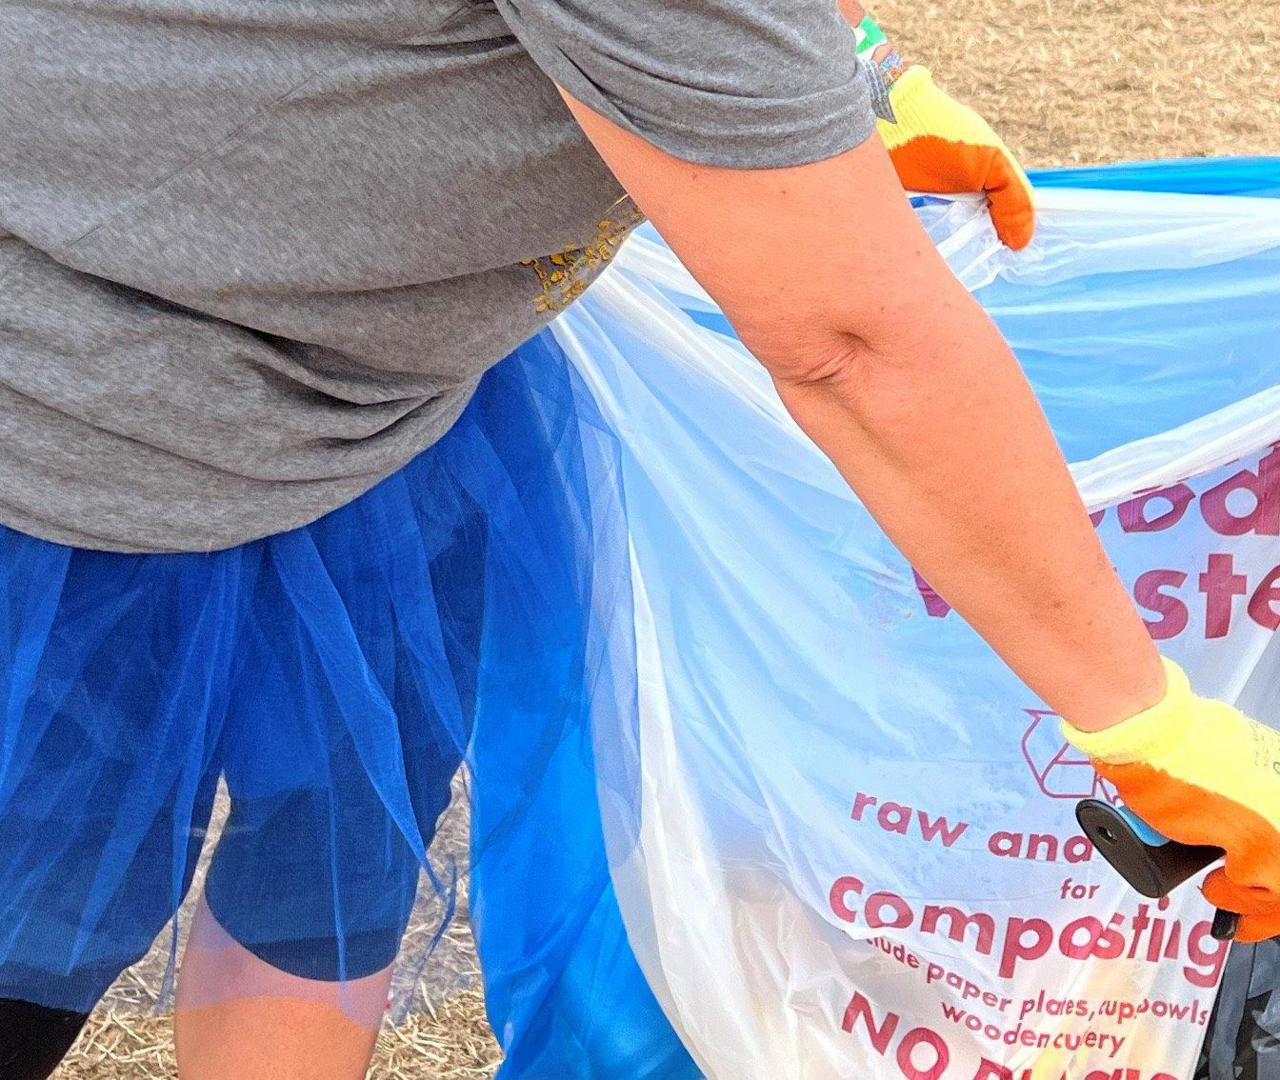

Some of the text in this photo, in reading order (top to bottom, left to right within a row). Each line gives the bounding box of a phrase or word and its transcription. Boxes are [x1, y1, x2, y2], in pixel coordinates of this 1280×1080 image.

[849, 791, 970, 848] raw
[1060, 877, 1101, 900] for
[927, 962, 1013, 1012] paper
[841, 990, 951, 1080] NO
